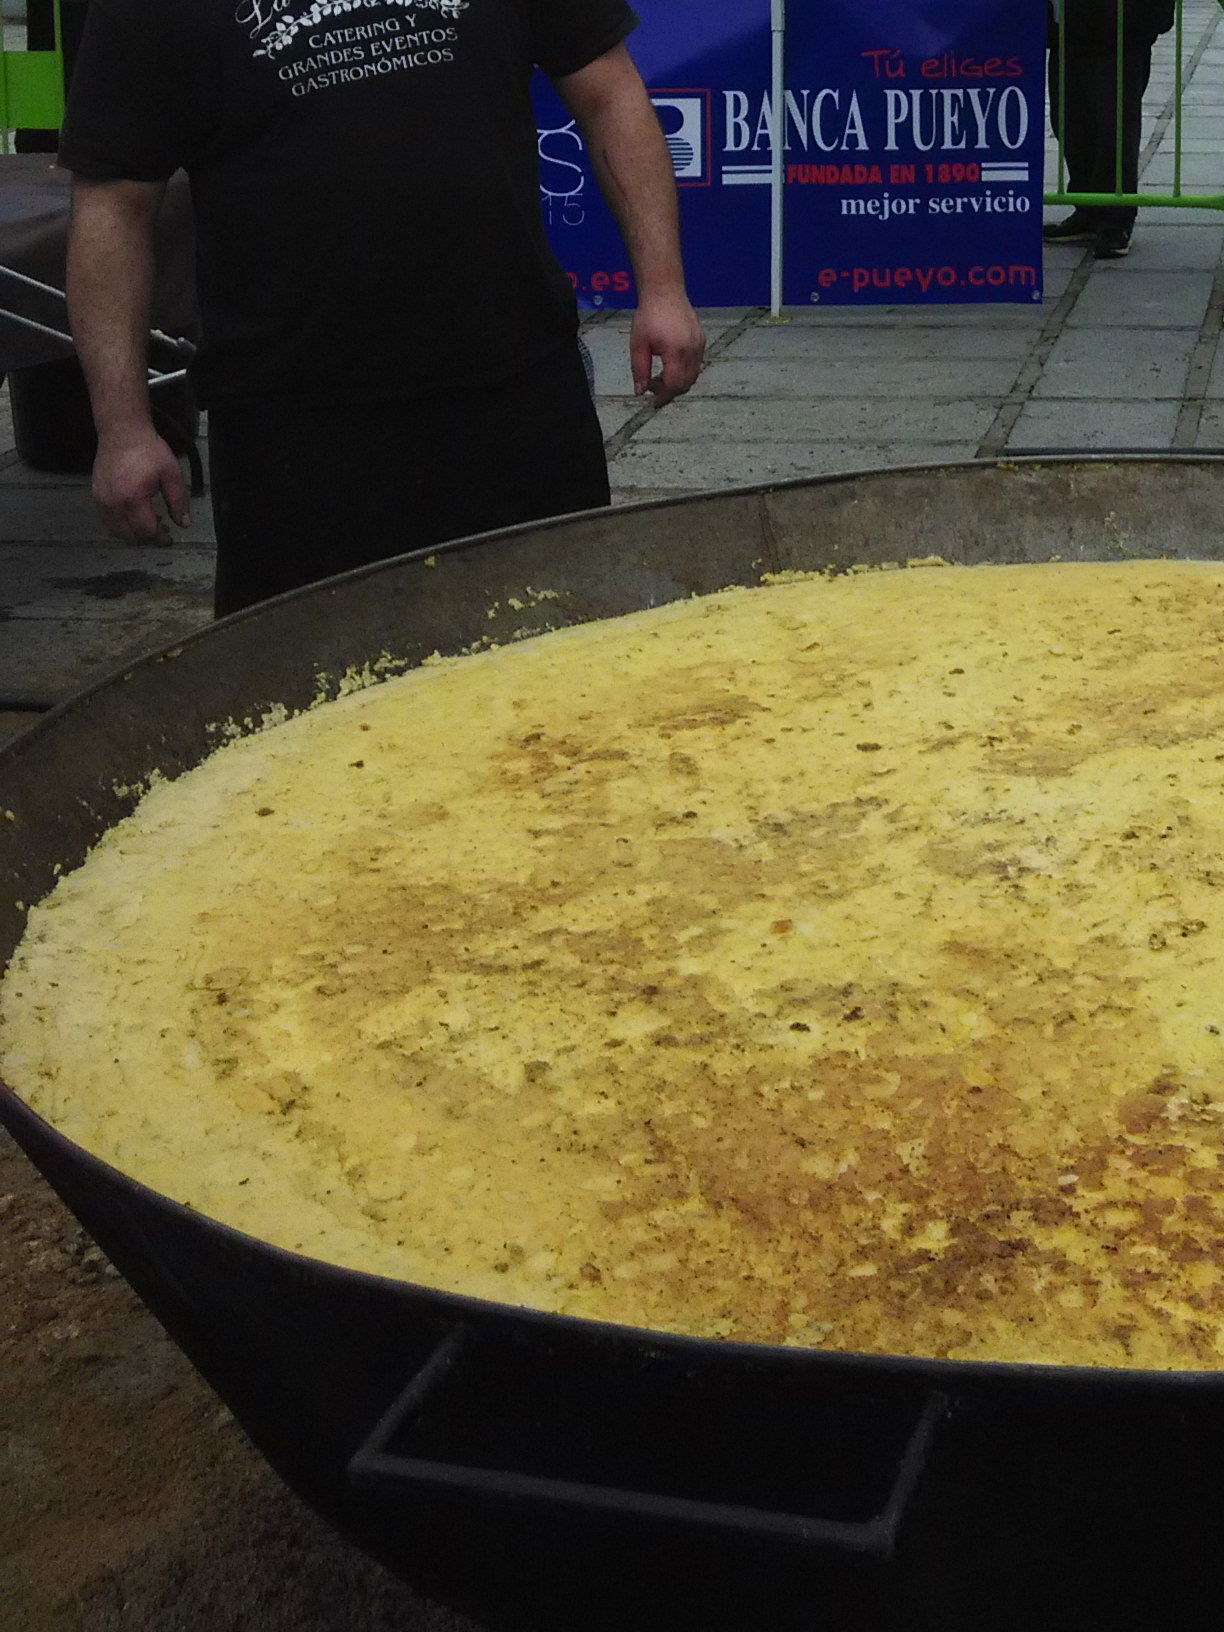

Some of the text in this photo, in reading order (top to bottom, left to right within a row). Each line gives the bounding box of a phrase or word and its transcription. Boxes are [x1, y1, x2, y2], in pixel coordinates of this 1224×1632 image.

[308, 12, 417, 49] CATERING Y
[278, 27, 459, 81] GRANDES EVENTOS
[861, 48, 1023, 79] Tú eliges
[291, 47, 455, 97] GASTRONÓMICOS
[722, 85, 1029, 152] BANCA PUEYO
[785, 162, 980, 185] FUNDADA EN 1890
[840, 189, 1030, 221] mejor servicio
[817, 264, 1036, 293] e-pueyo.com
